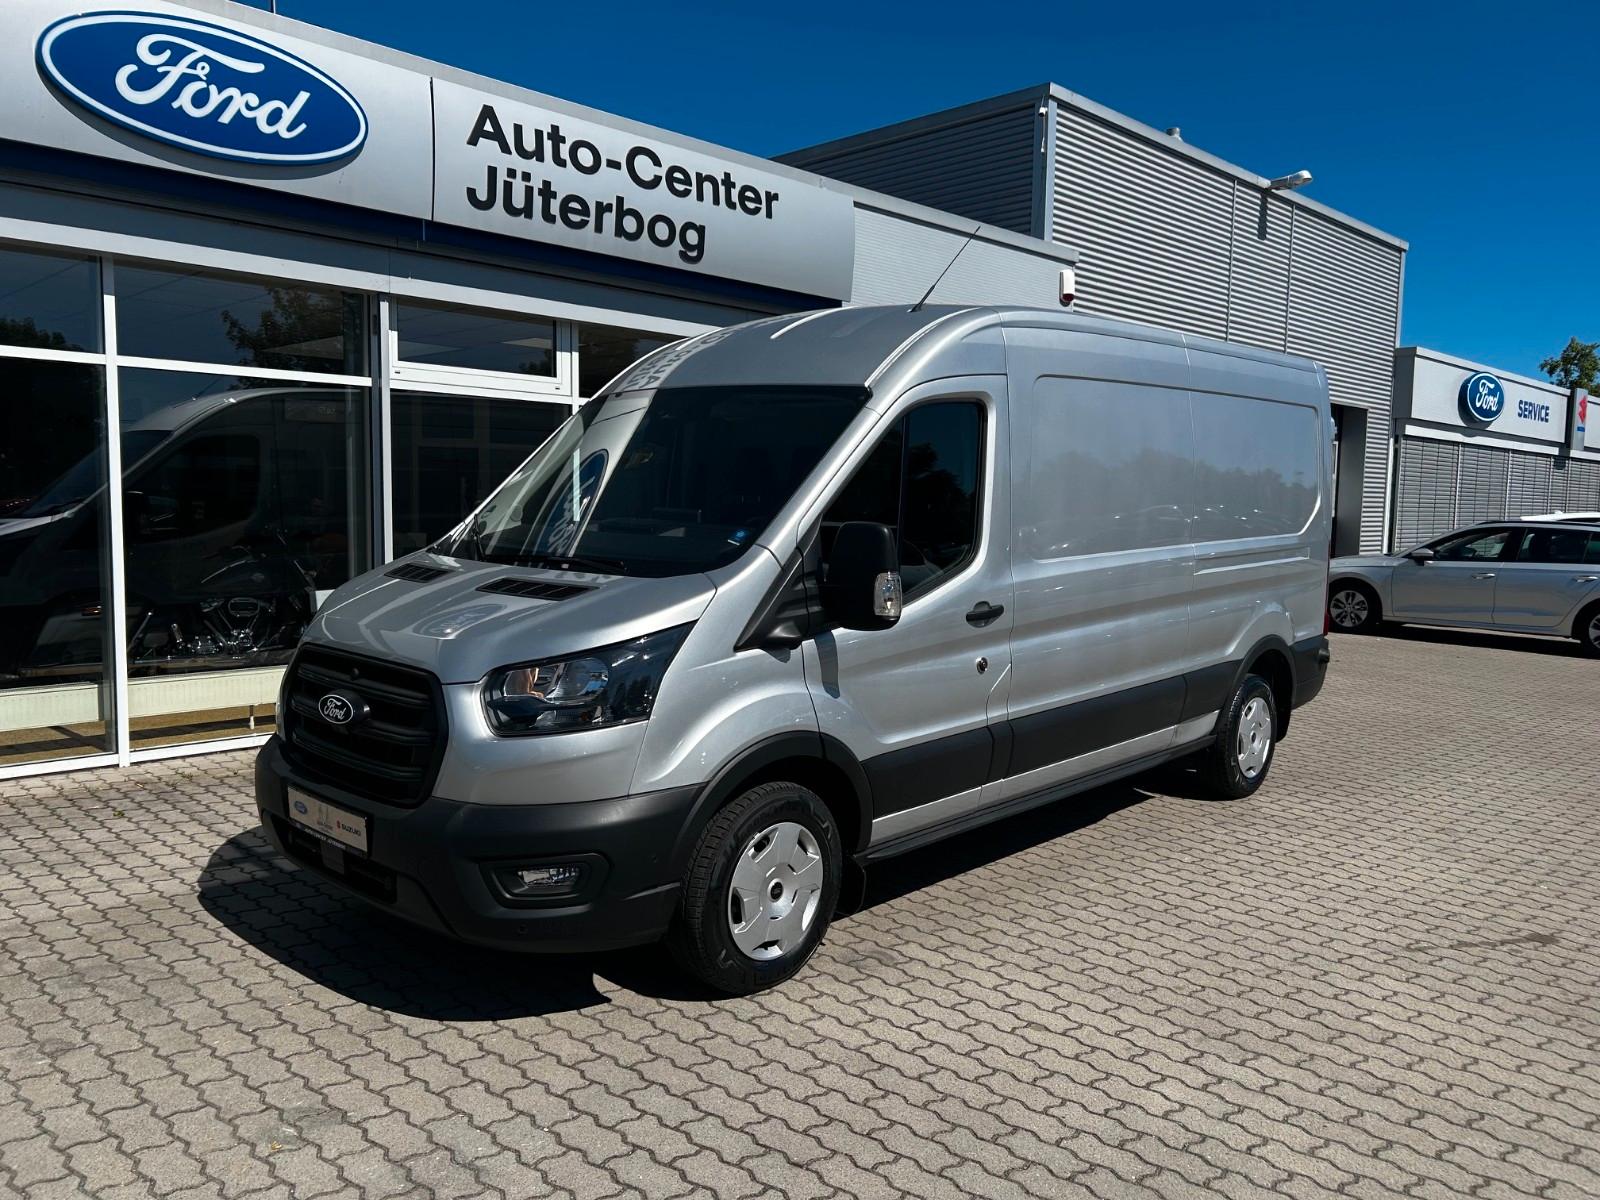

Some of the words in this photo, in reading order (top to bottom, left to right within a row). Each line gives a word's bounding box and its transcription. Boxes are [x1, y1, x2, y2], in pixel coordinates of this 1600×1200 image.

[115, 33, 308, 140] Ford
[467, 104, 780, 220] Auto-Center
[466, 166, 707, 263] Jüterbog
[1475, 379, 1499, 411] Ford
[1517, 400, 1550, 423] SERVICE
[323, 698, 346, 720] Ford
